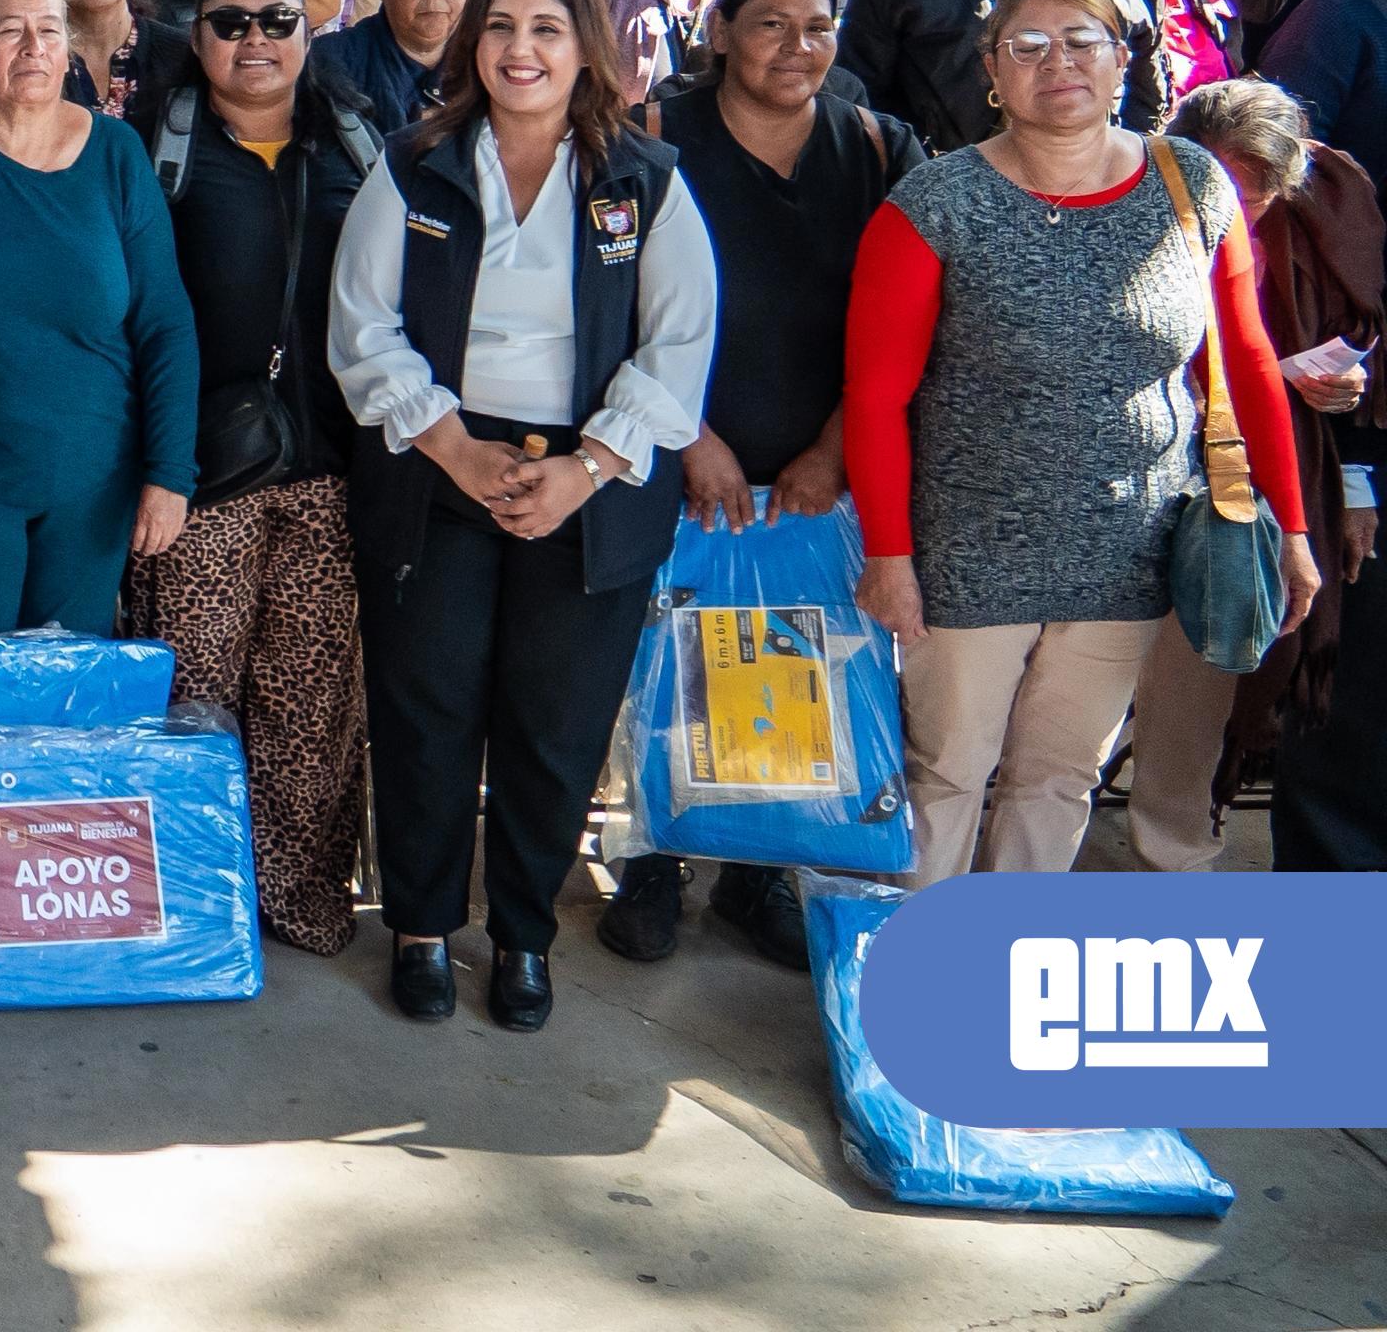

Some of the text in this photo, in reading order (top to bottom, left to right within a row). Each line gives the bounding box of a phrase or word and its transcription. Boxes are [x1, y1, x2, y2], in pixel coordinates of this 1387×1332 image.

[597, 238, 638, 254] TIJUAN
[716, 614, 725, 625] m
[715, 627, 726, 635] 6
[718, 647, 728, 658] m
[718, 661, 729, 669] 6
[691, 722, 710, 779] PRETUL
[28, 822, 75, 835] TIJUANA
[80, 827, 139, 840] BIENESTAR
[15, 855, 131, 887] APOYO
[21, 889, 132, 921] LONAS
